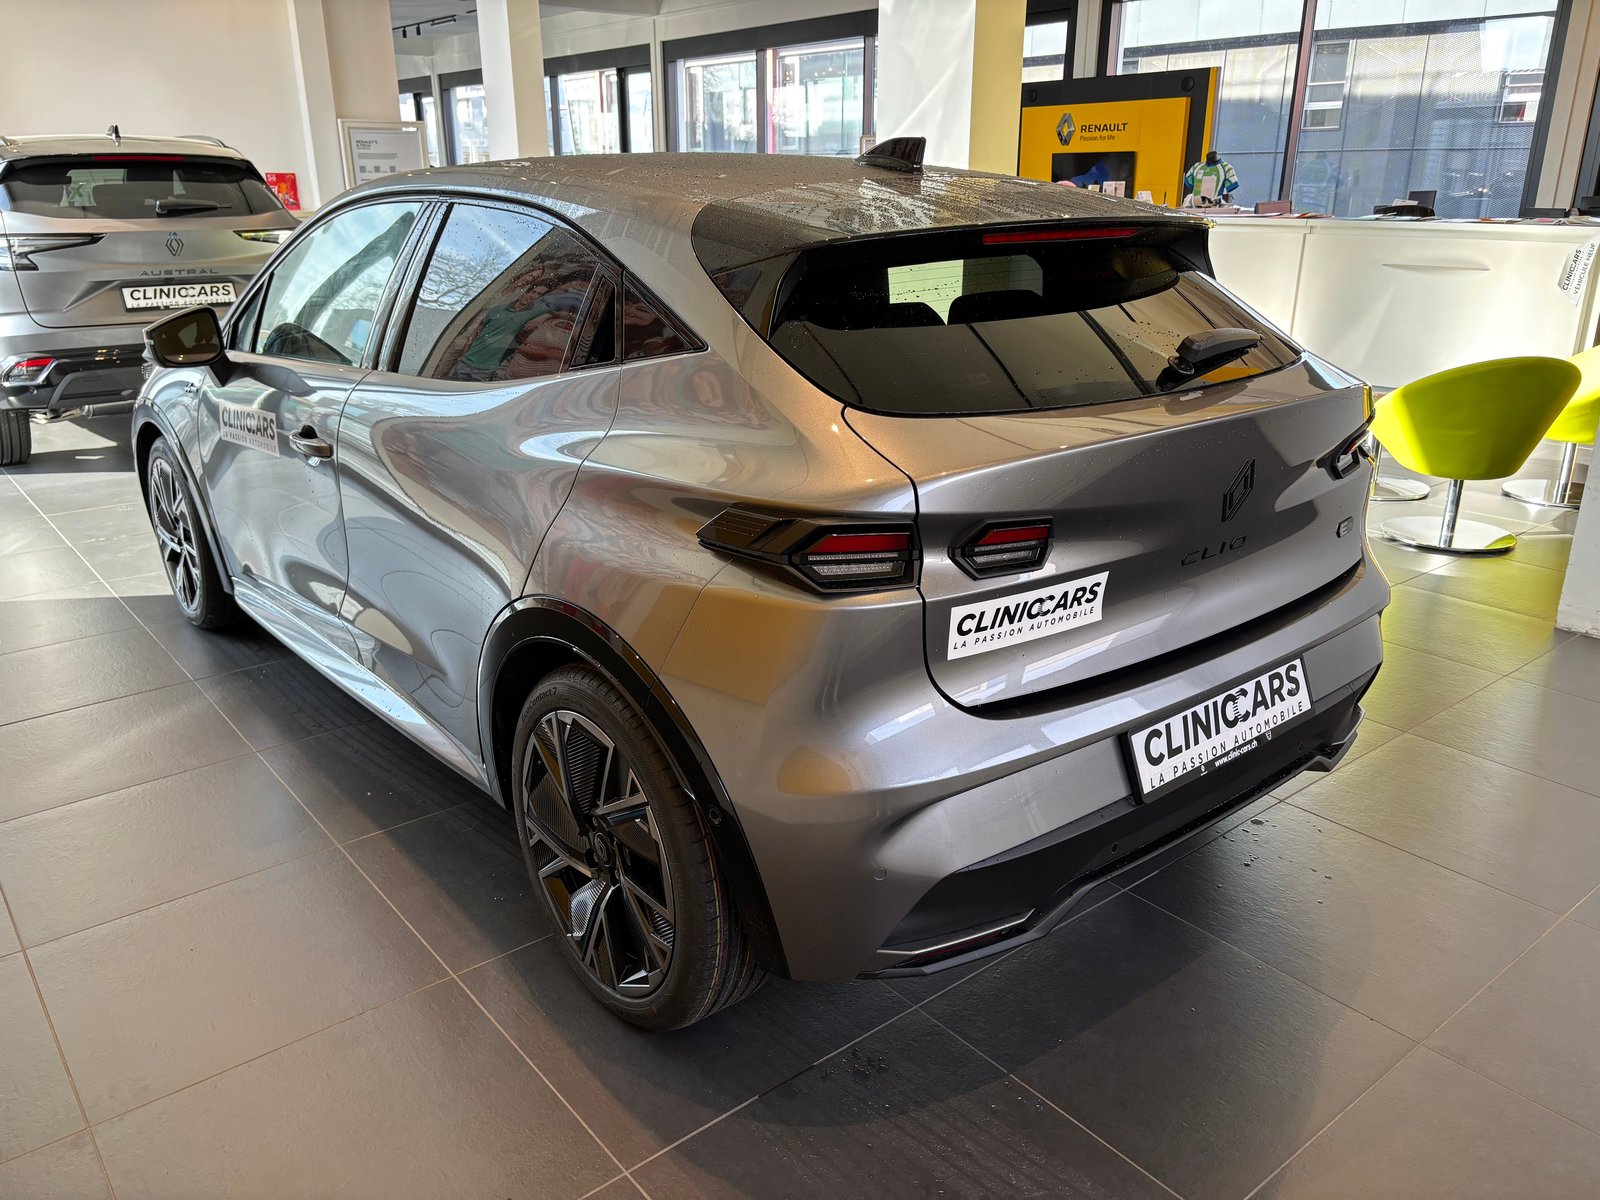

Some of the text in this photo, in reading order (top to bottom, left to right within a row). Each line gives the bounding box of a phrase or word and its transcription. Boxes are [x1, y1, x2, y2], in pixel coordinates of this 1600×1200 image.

[1080, 122, 1129, 133] RENAULT
[1107, 133, 1116, 141] life
[1586, 243, 1597, 261] NEUF
[139, 268, 220, 277] AUSTRAL
[1562, 249, 1582, 291] CLINICCARS
[130, 284, 231, 301] CLINICCARS
[222, 406, 276, 441] CLINICCARS
[1181, 534, 1248, 567] CLIO
[956, 581, 1102, 637] CLINICCARS
[953, 605, 1096, 650] LA PASSION AUTOMOBILE
[1144, 663, 1301, 767] CLINICCARS
[1150, 700, 1304, 789] LA PASSION AUTOMOBILE
[1214, 739, 1259, 768] www.clinic-cars.ch
